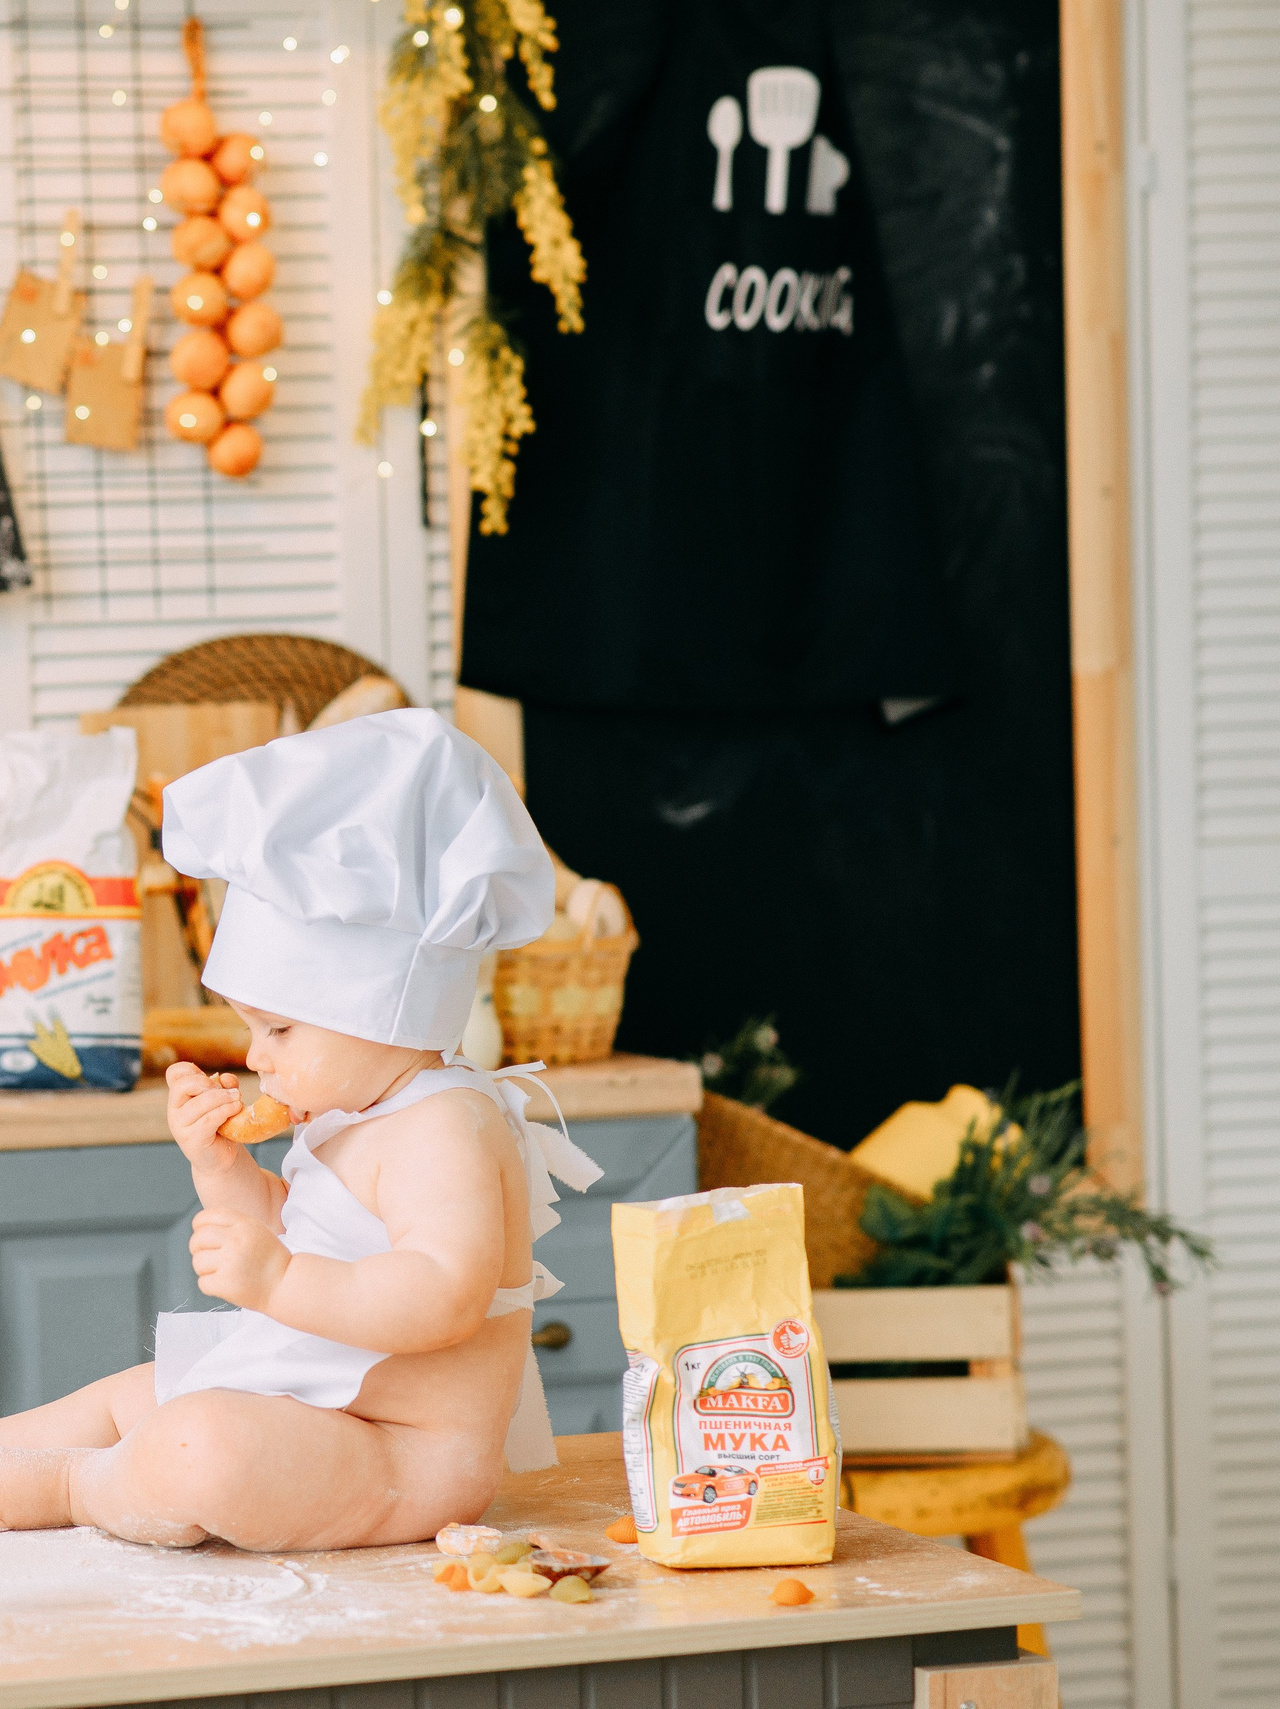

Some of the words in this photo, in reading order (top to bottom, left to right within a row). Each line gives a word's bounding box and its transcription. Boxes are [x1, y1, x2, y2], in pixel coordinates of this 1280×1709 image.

[705, 1394, 784, 1411] MAKFA
[698, 1420, 793, 1432] ПШЕНИЧНАЯ
[703, 1432, 792, 1452] МУКА
